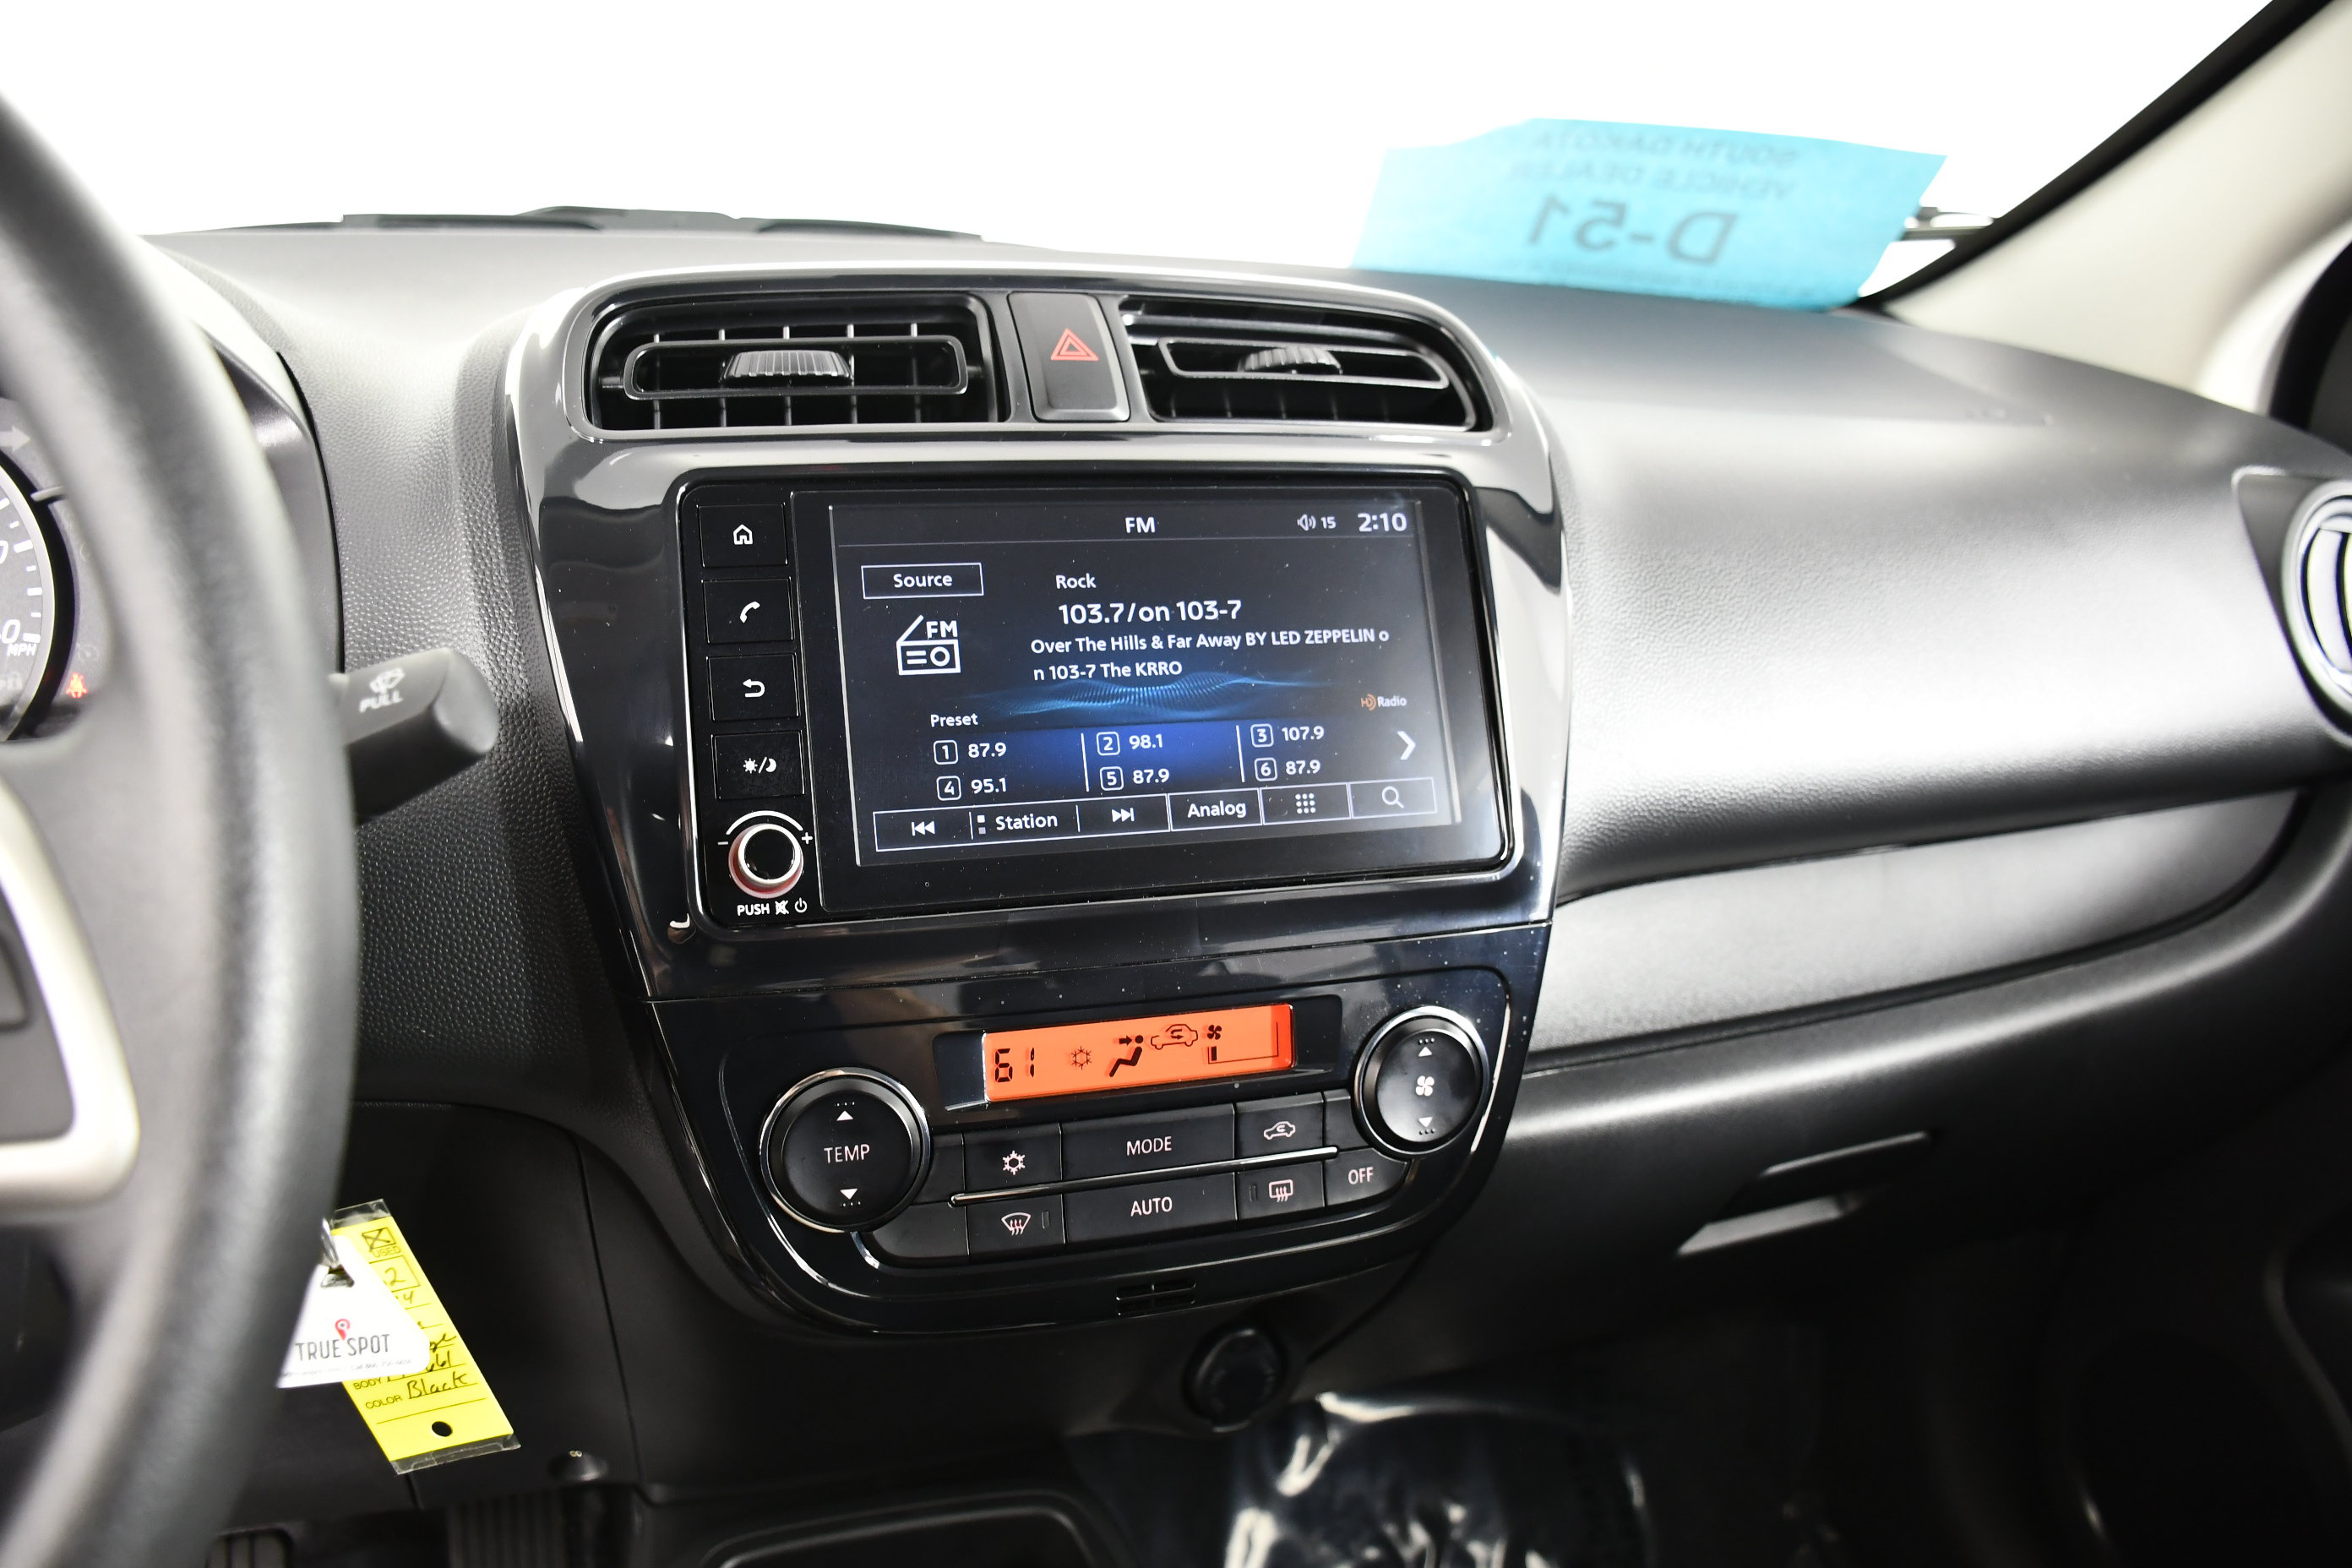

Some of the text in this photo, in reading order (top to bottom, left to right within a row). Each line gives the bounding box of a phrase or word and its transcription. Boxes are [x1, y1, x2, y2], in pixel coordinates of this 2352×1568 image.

[1125, 516, 1156, 533] FM
[1320, 515, 1337, 530] 15
[1358, 512, 1407, 532] 2:10
[893, 573, 953, 588] Source
[1056, 573, 1097, 590] Rock
[1059, 599, 1242, 624] 103.7/on 103-7
[0, 619, 21, 645] 0
[926, 620, 958, 639] FM
[7, 643, 38, 656] MPH
[1031, 629, 1390, 654] Over The Hills & Far Away BY LED ZEPPELIN o
[1033, 661, 1183, 681] n 103-7 The KRRO
[359, 690, 405, 712] PULL
[1377, 695, 1407, 707] Radio
[930, 713, 978, 727] Preset
[1102, 733, 1163, 751] 2 98.1
[1257, 725, 1325, 743] 3 107.9
[941, 742, 1006, 760] 1 87.9
[1260, 760, 1321, 776] 6 87.9
[944, 777, 1007, 795] 4 95.1
[1106, 768, 1170, 787] 5 87.9
[1187, 799, 1247, 819] Analog
[995, 813, 1059, 831] Station
[737, 902, 770, 917] PUSH
[994, 1047, 1035, 1083] 61
[823, 1143, 870, 1164] TEMP
[1126, 1135, 1173, 1157] MODE
[1348, 1166, 1374, 1184] OFF
[1130, 1196, 1173, 1217] AUTO
[372, 1244, 401, 1258] USED
[296, 1333, 390, 1362] TRUE SPOT
[353, 1377, 382, 1390] BODY
[406, 1371, 469, 1399] Black
[366, 1394, 403, 1409] COLOR
